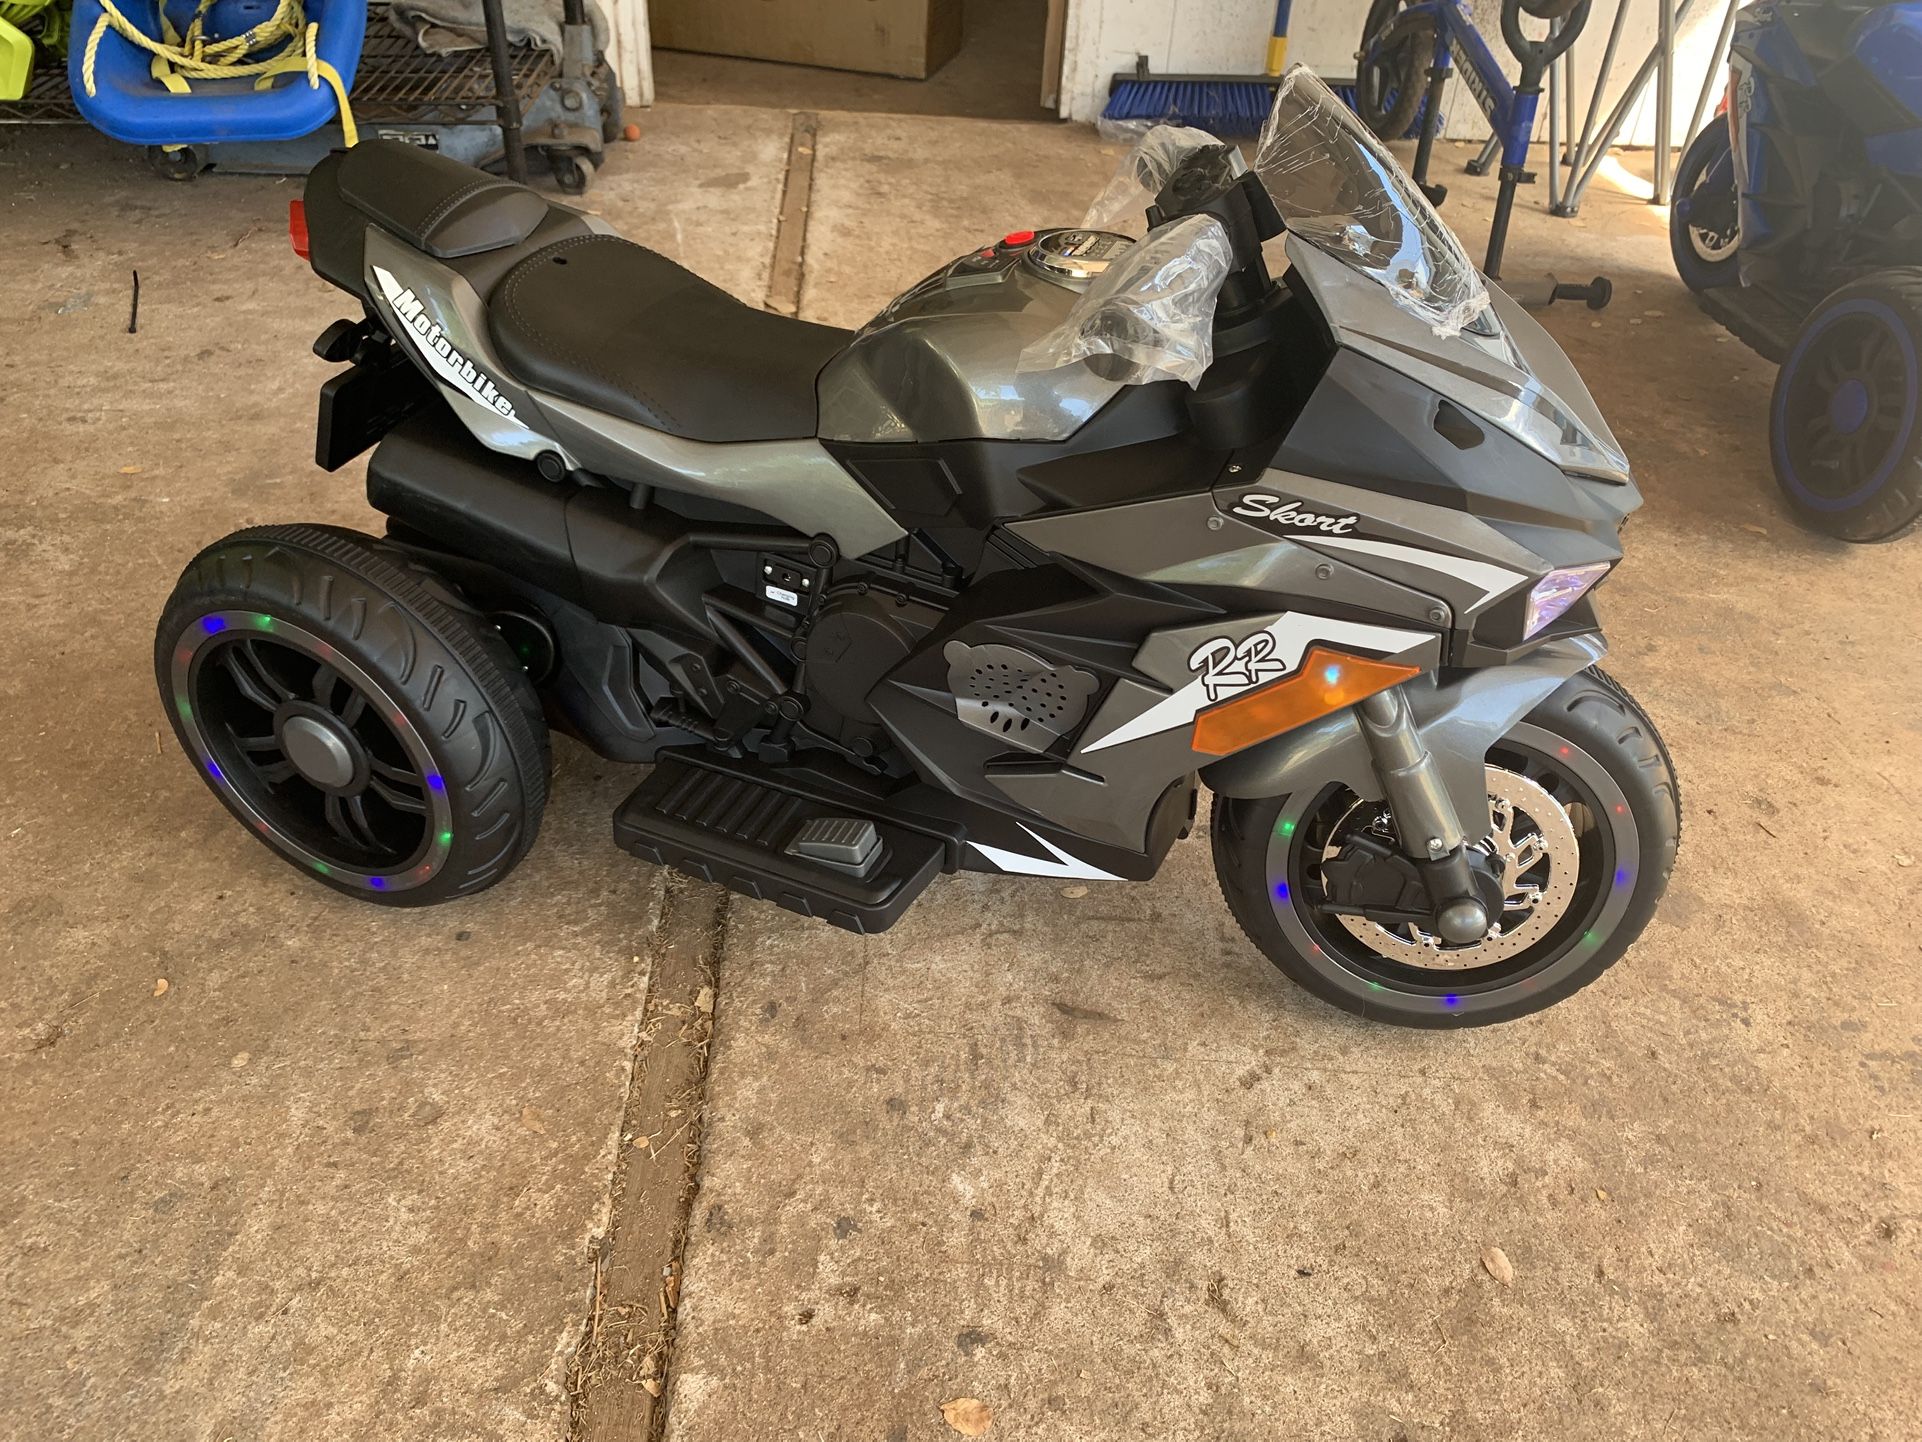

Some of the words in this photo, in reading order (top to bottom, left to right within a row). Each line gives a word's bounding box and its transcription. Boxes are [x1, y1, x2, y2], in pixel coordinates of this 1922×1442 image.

[1449, 37, 1496, 119] STRIDER
[391, 286, 515, 416] Motorbike
[1232, 494, 1358, 534] Skort
[1187, 629, 1287, 701] RR
